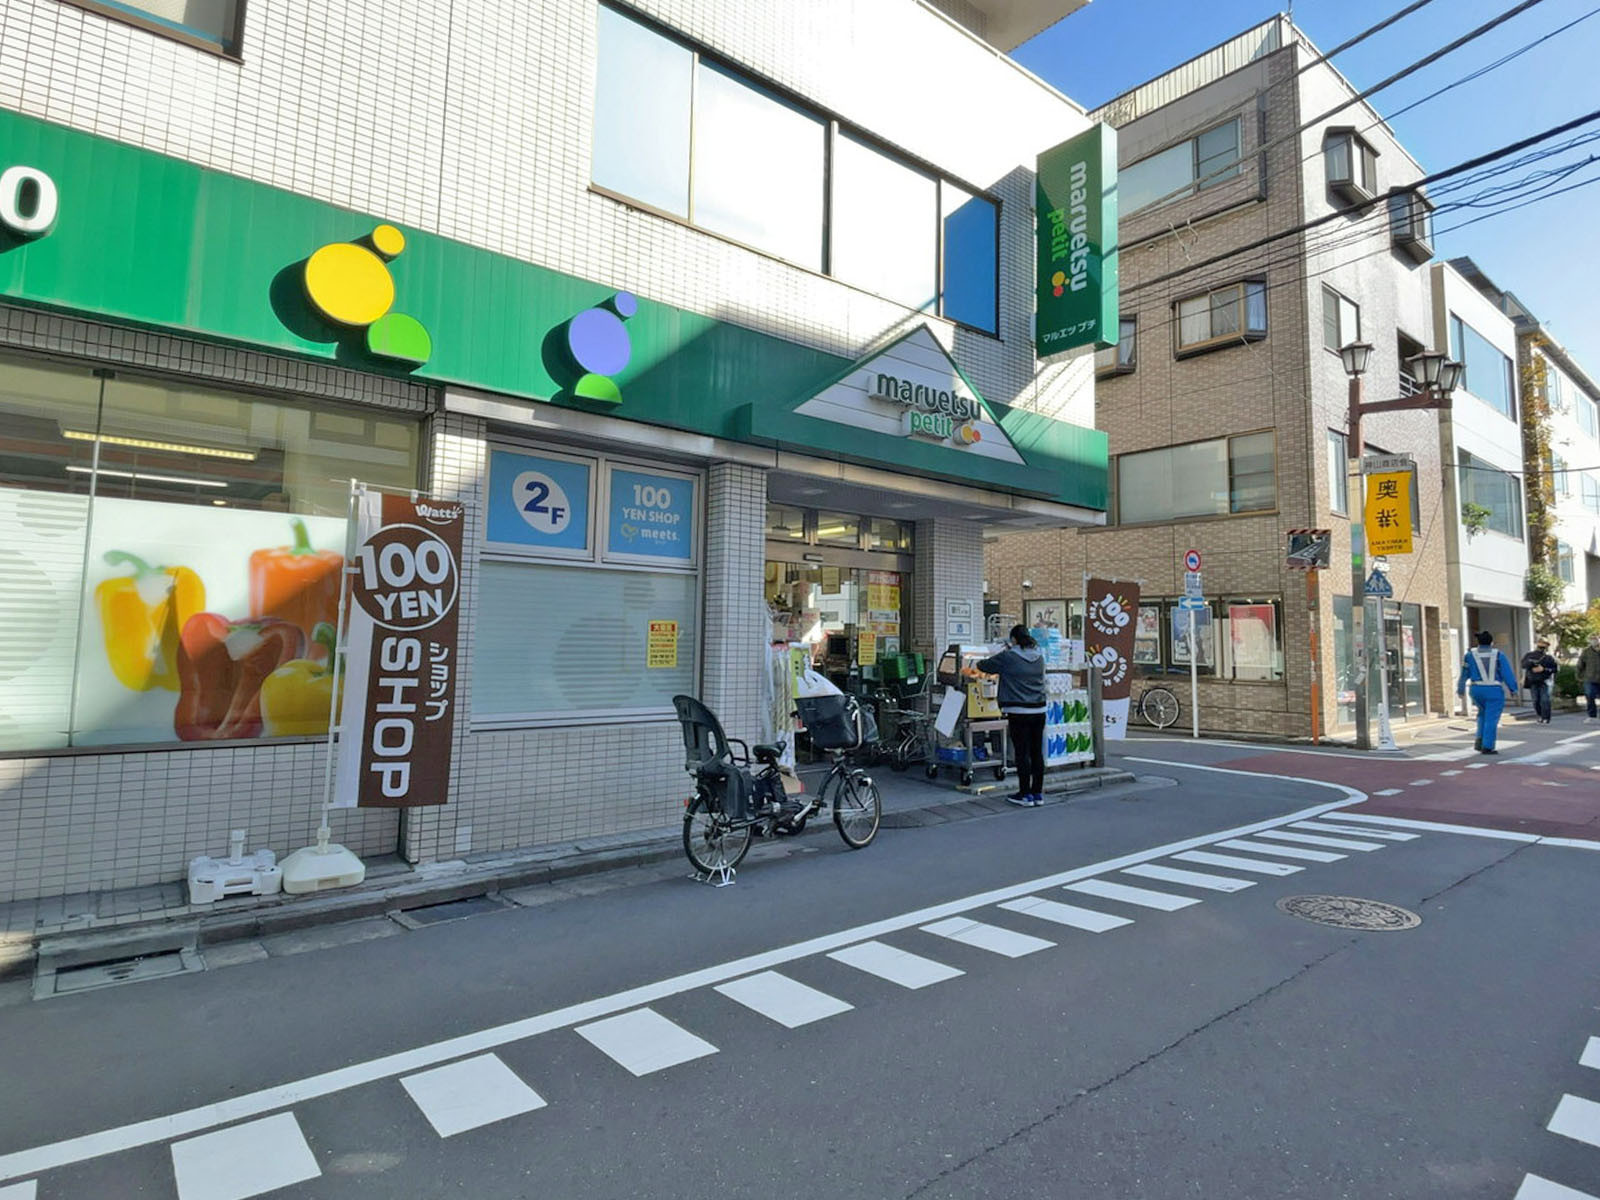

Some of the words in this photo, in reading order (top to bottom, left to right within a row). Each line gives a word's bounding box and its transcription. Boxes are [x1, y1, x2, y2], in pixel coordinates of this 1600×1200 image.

[1048, 208, 1069, 261] petit
[1070, 161, 1090, 292] maruetsu
[1042, 325, 1076, 343] マルエツ
[1077, 319, 1096, 333] プチ
[877, 373, 981, 420] maruetsu
[909, 410, 953, 438] petit
[415, 504, 458, 518] Watts
[633, 484, 671, 509] 100
[622, 507, 646, 521] YEN
[648, 511, 680, 525] SHOP
[355, 540, 449, 590] 100
[373, 589, 443, 621] YEN
[1089, 601, 1099, 619] YEN
[1100, 593, 1130, 627] 100
[1093, 621, 1120, 635] SHOP
[425, 642, 449, 721] ショップ
[1113, 656, 1128, 683] SHOP
[370, 637, 421, 798] SHOP
